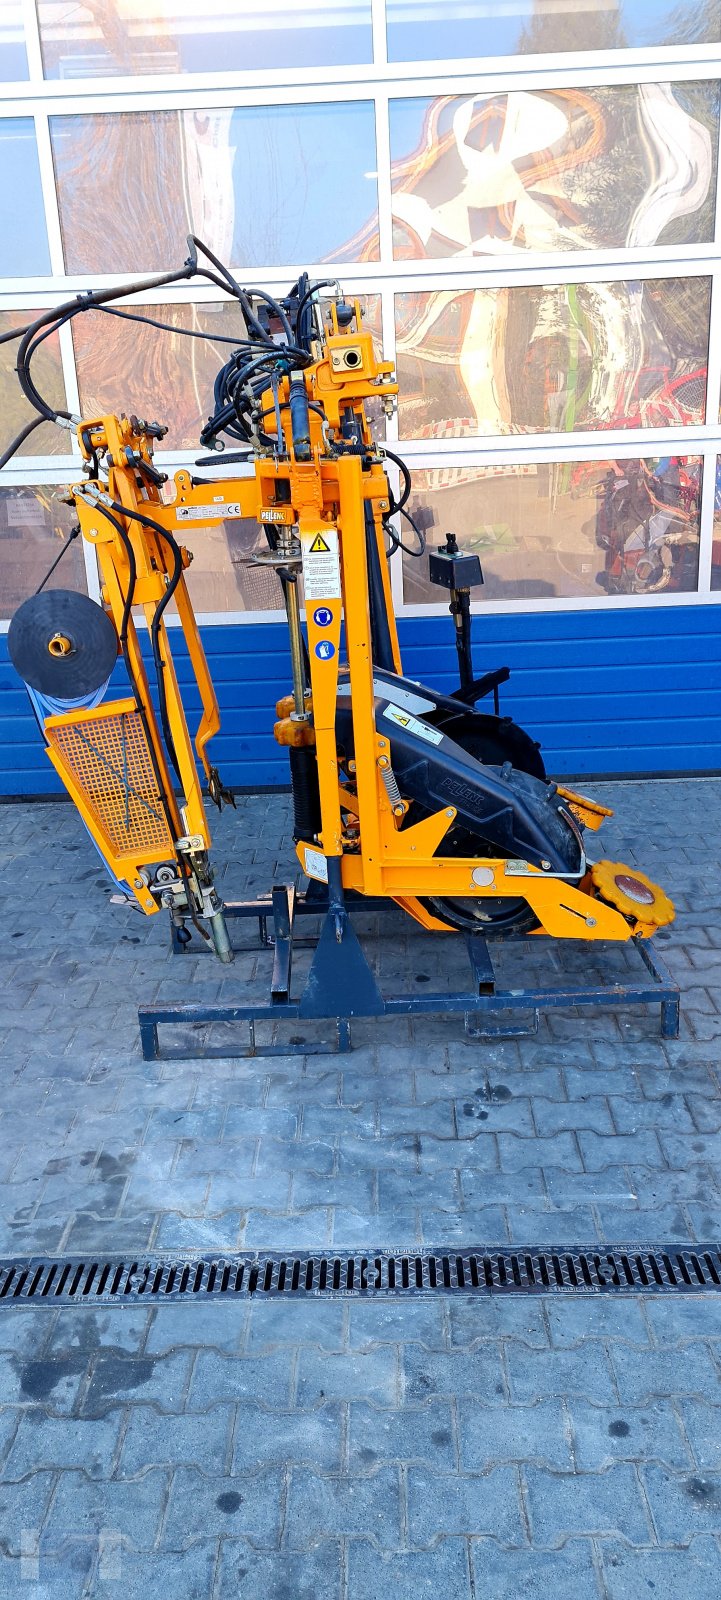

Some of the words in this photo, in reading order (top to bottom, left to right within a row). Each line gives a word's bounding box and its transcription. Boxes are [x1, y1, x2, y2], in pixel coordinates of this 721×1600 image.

[227, 505, 240, 515] CE
[261, 509, 285, 522] PELLENC
[440, 777, 485, 806] PELLENC
